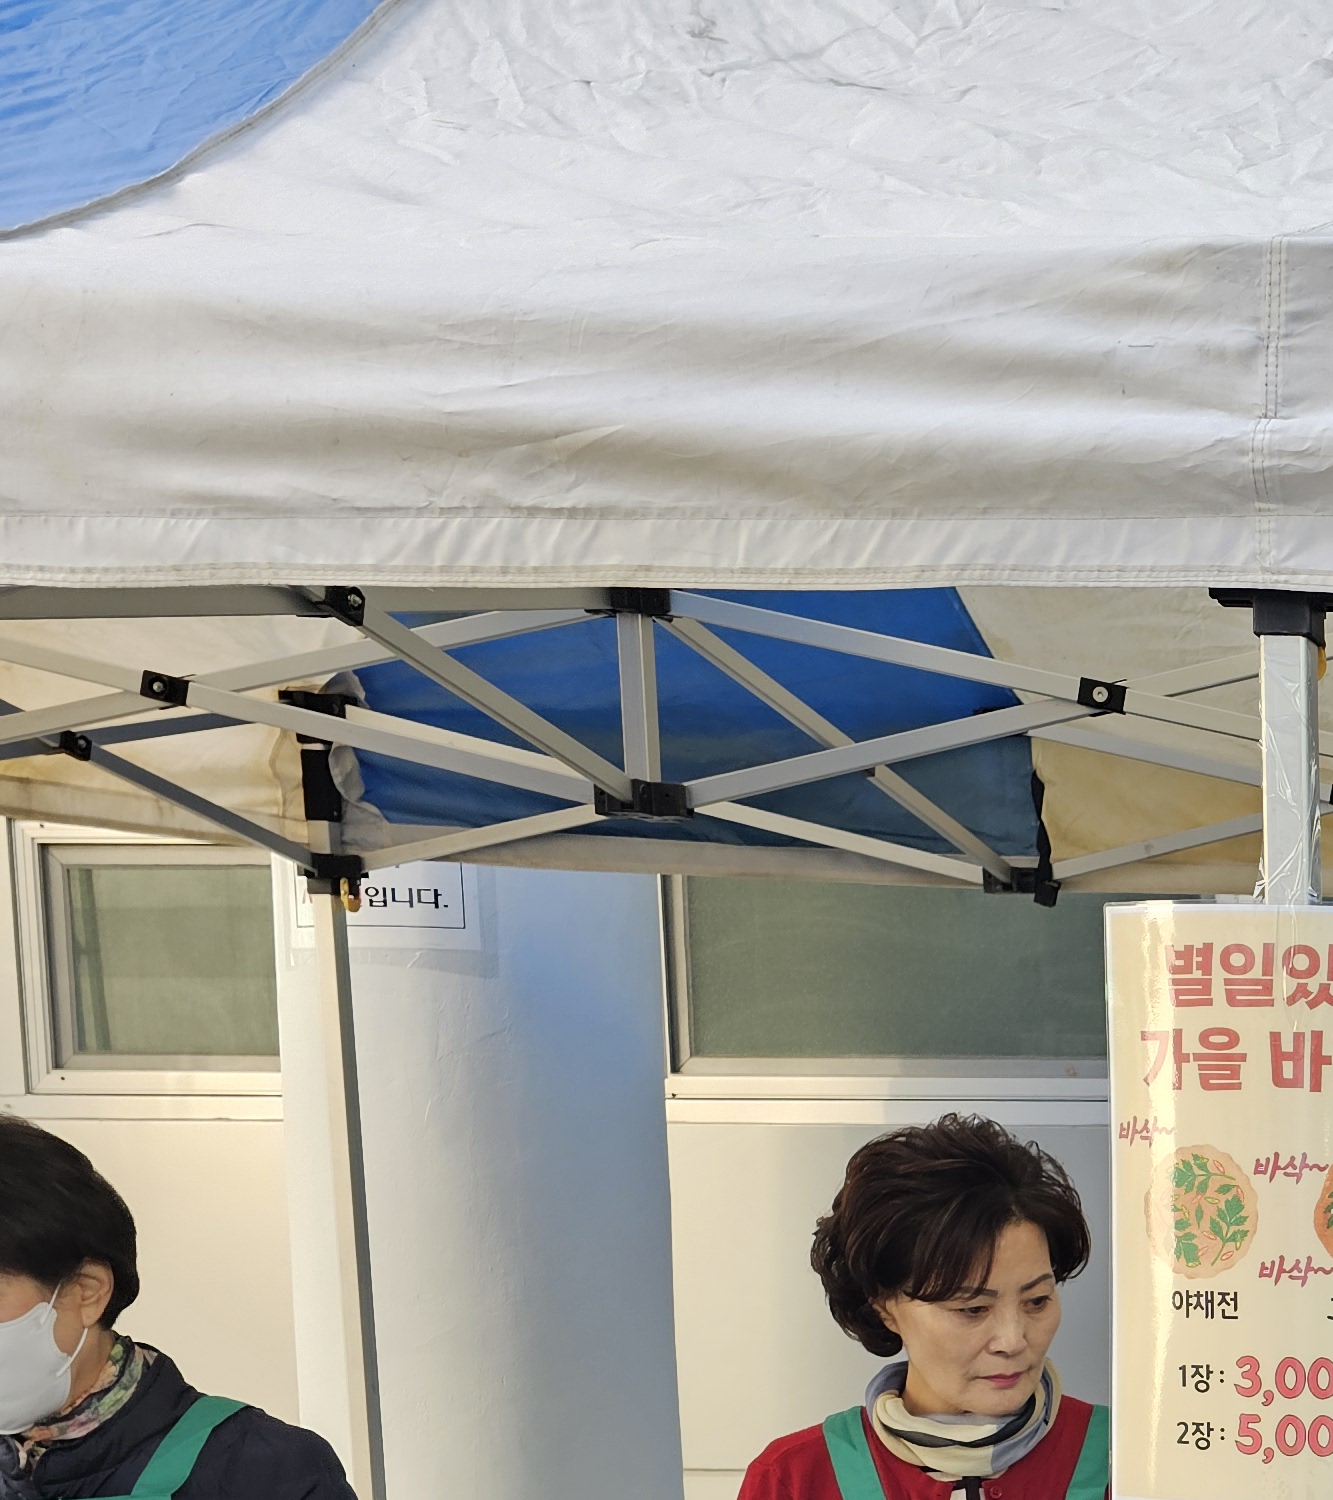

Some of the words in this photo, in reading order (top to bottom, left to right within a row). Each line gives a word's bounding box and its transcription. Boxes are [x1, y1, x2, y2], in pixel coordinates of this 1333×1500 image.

[363, 885, 449, 910] 입니다.
[1141, 1029, 1248, 1092] 가을
[1172, 1290, 1239, 1321] 야채전
